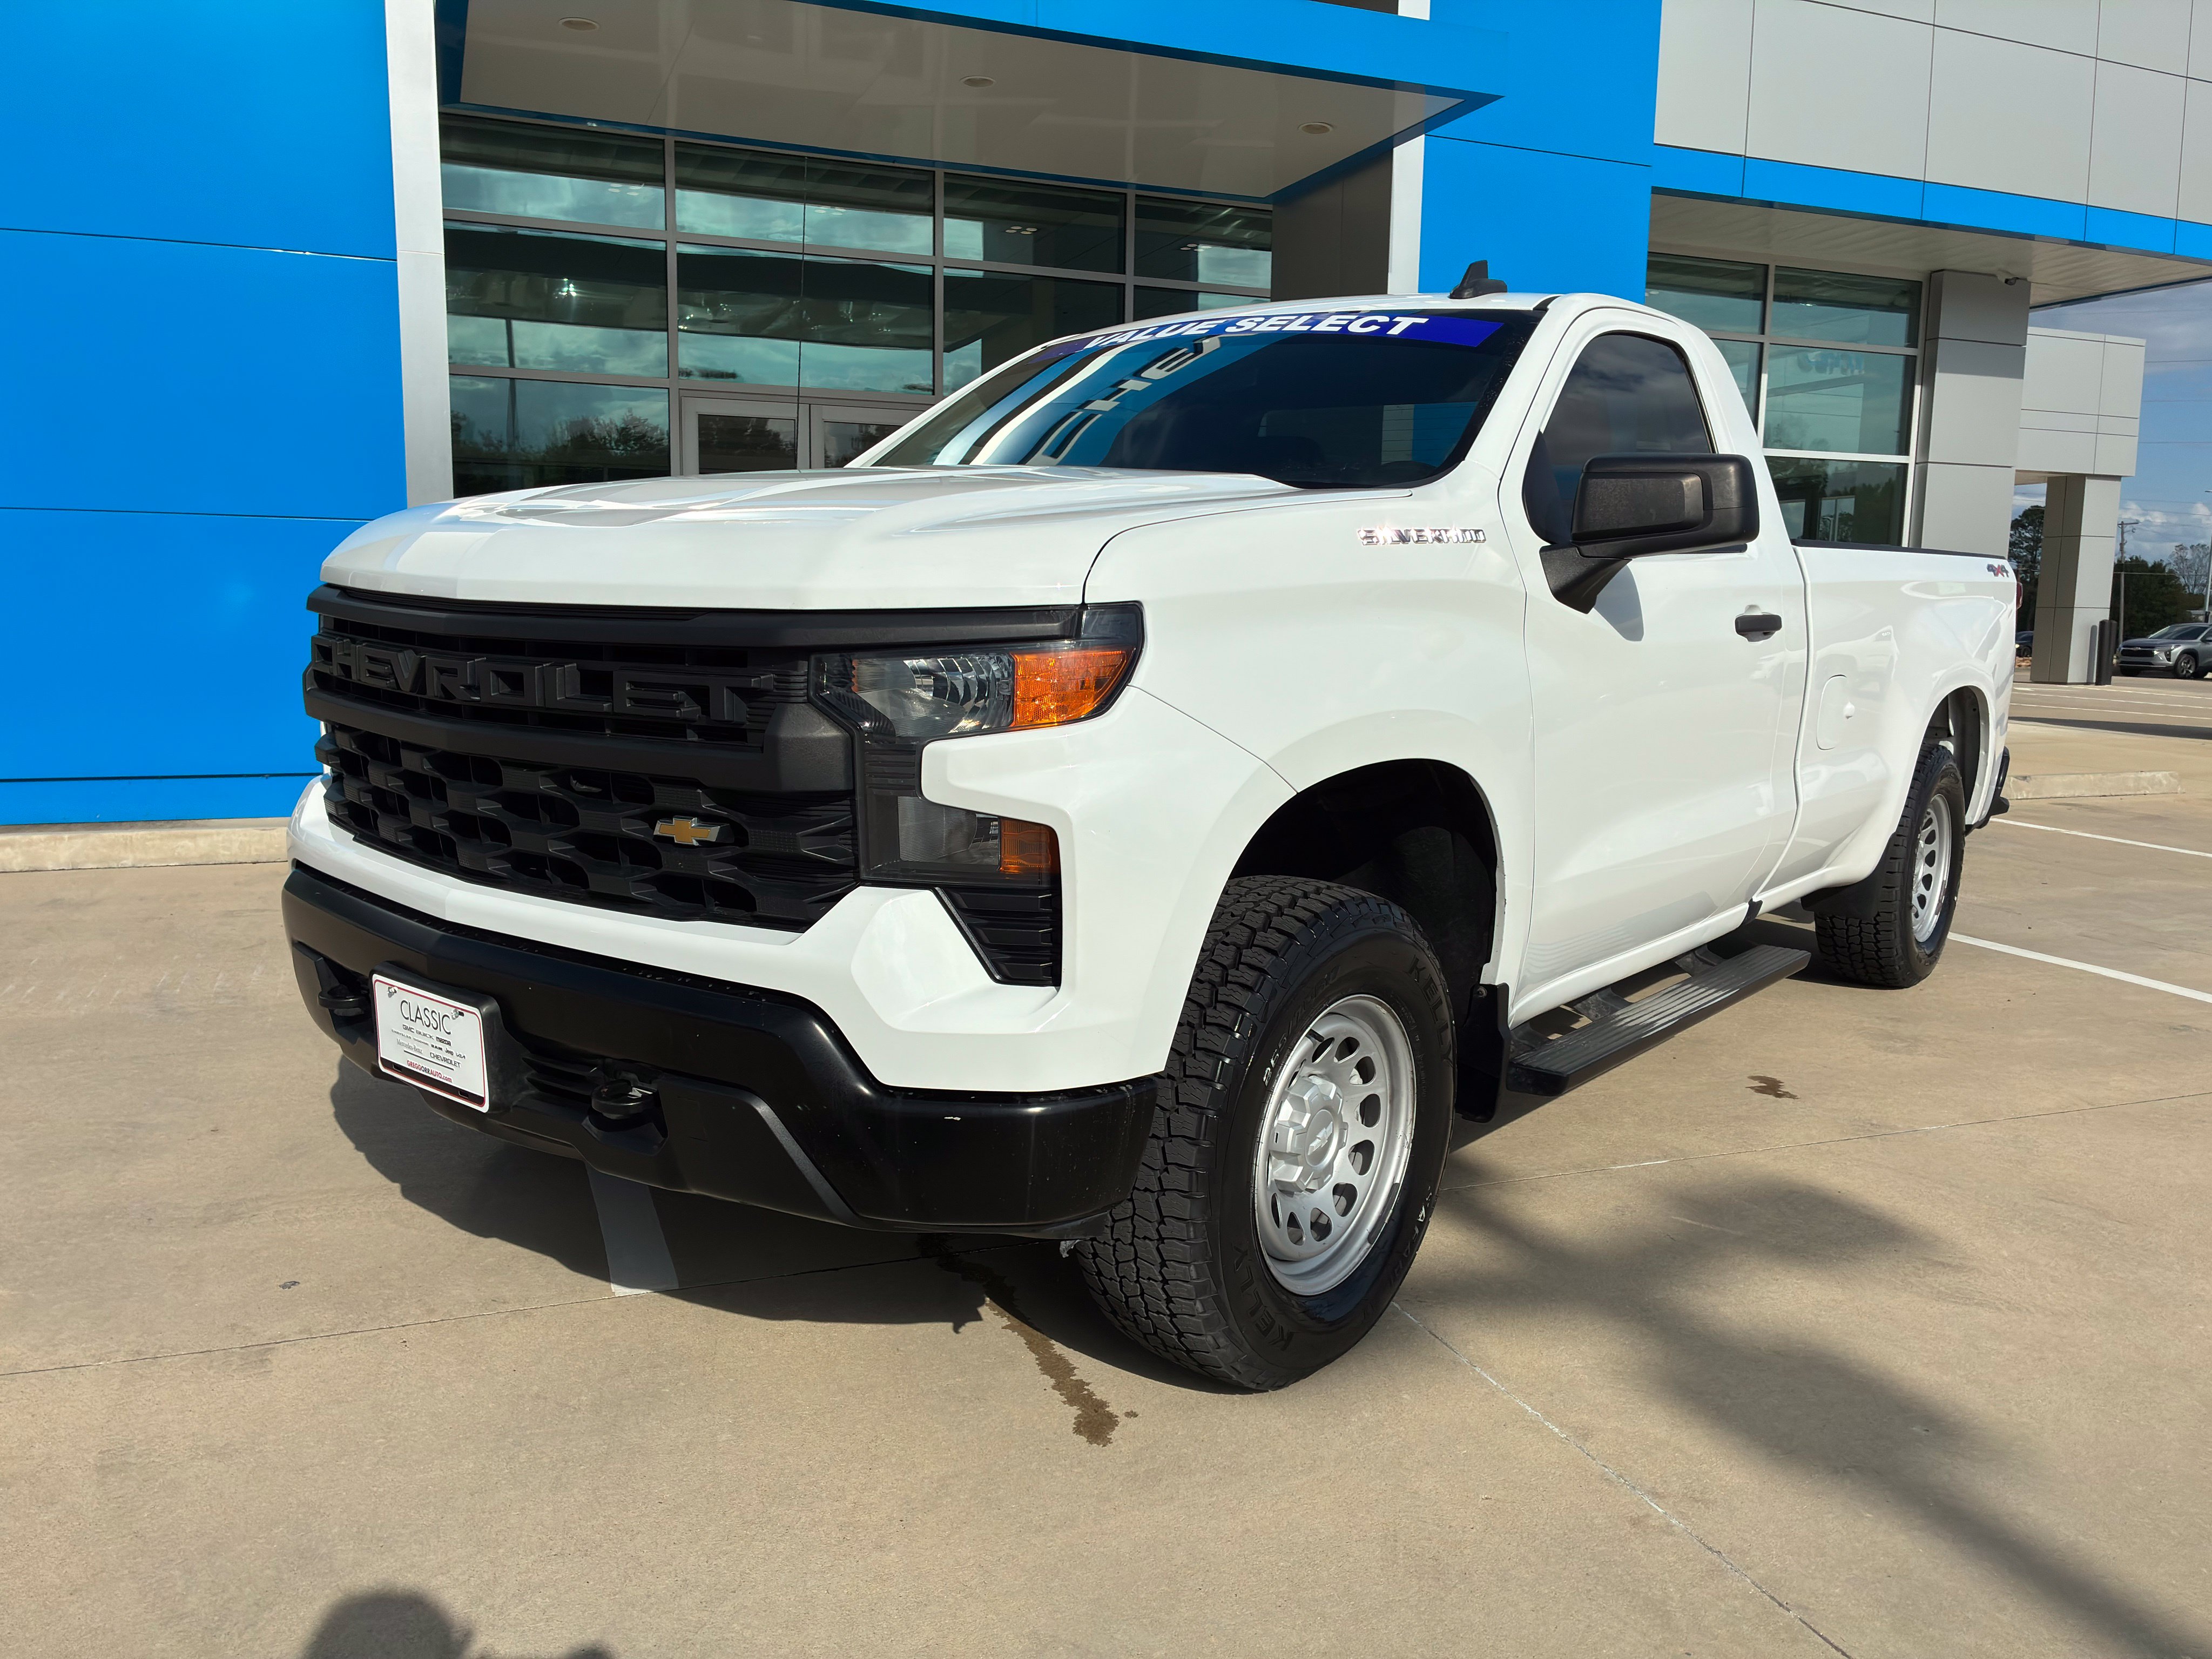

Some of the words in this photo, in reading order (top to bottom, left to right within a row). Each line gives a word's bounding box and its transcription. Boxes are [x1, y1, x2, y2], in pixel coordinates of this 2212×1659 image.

[1082, 320, 1227, 349] VALUE
[1225, 315, 1429, 336] SELECT
[311, 634, 773, 725] CHEVROLET
[400, 1000, 451, 1035] CLASSIC
[1407, 954, 1454, 1068] KELLY
[402, 1024, 415, 1034] GMC
[416, 1029, 434, 1040] BUICK
[429, 1052, 461, 1068] CHEVROLET
[444, 1048, 454, 1056] Jeep
[407, 1060, 453, 1083] GREGGORRAUTO.com
[1231, 1243, 1294, 1352] KELLY
